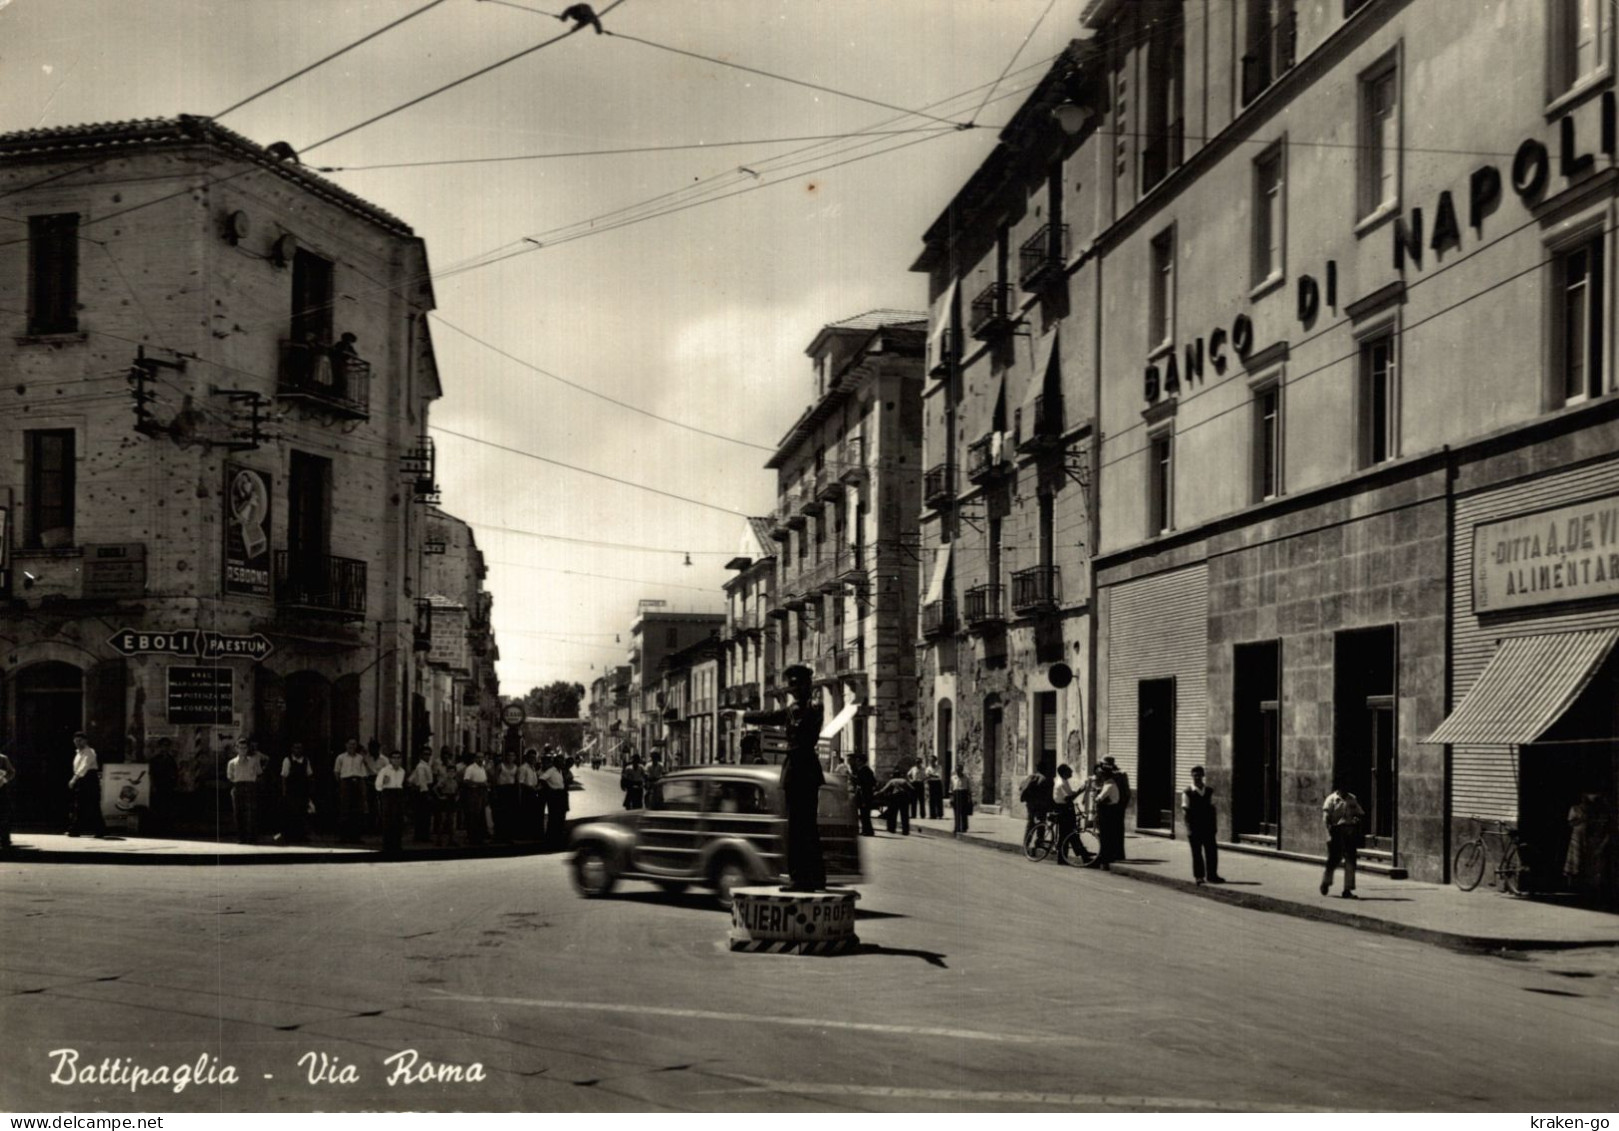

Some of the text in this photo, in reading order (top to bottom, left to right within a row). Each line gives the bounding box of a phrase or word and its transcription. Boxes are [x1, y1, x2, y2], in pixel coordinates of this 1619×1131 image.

[1144, 90, 1617, 402] BANCO DI NAPOLI
[1506, 552, 1619, 596] ALIMENTAR
[124, 635, 188, 650] EBOLI
[210, 639, 266, 652] PAESTUM
